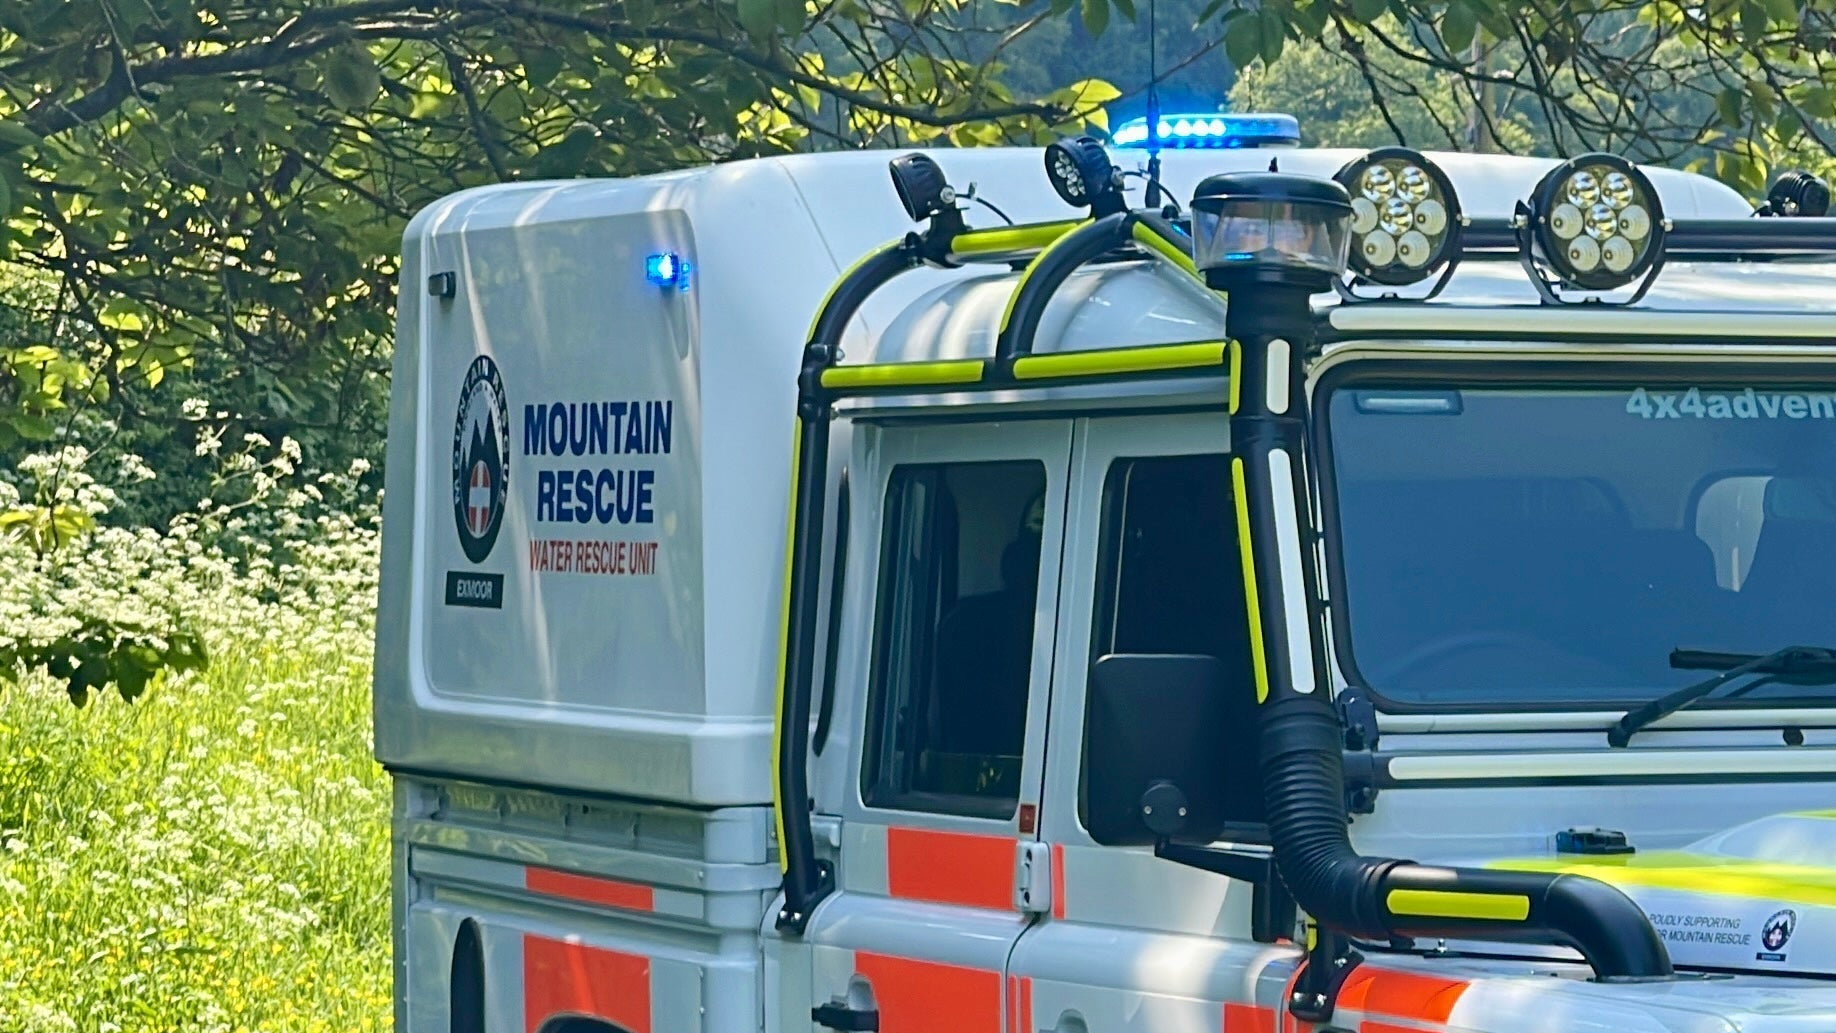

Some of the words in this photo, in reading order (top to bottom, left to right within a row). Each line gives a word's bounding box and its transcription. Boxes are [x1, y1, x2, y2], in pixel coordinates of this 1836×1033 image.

[523, 400, 673, 457] MOUNTAIN
[537, 468, 655, 525] RESCUE
[529, 538, 573, 573] WATER
[575, 540, 626, 575] RESCUE
[628, 542, 658, 576] UNIT
[456, 579, 493, 601] EXMOOR
[1684, 915, 1741, 929] SUPPORTING
[1668, 930, 1713, 943] MOUNTAIN
[1714, 933, 1752, 946] RESCUE
